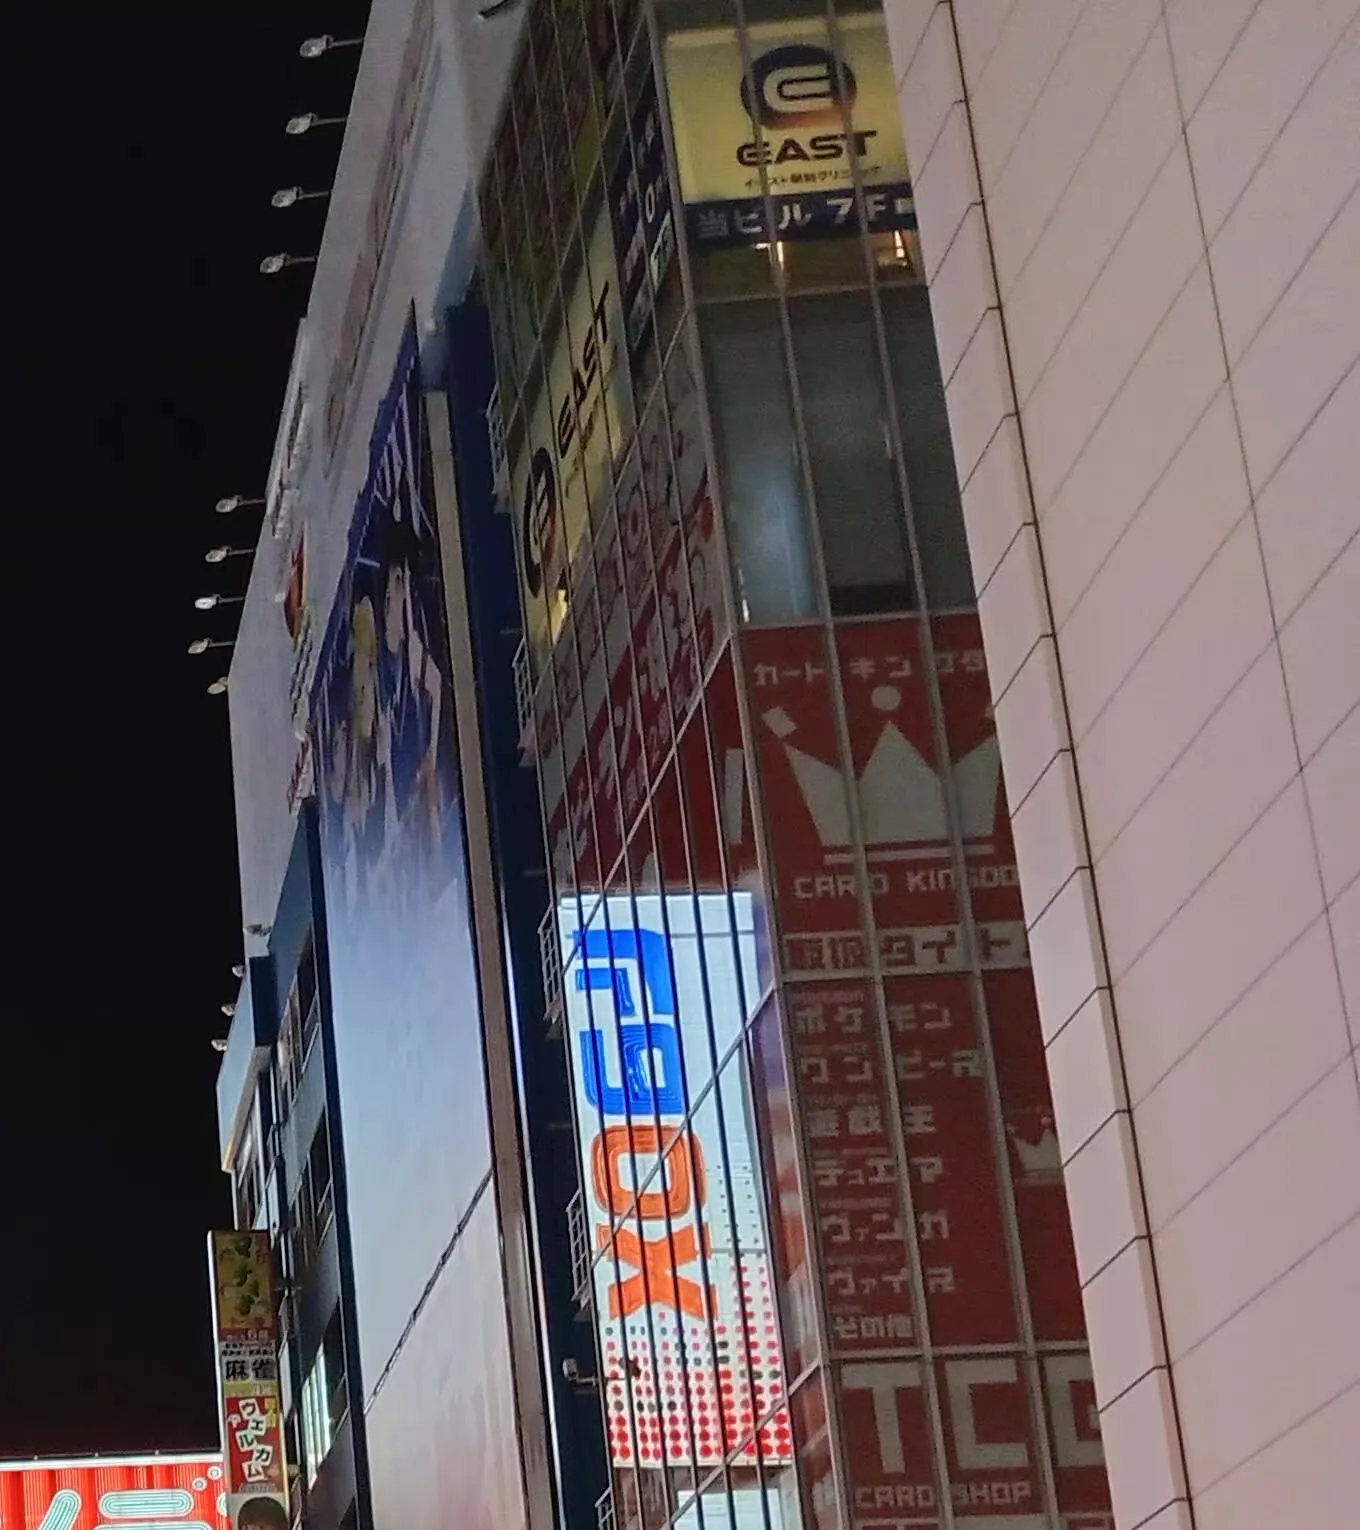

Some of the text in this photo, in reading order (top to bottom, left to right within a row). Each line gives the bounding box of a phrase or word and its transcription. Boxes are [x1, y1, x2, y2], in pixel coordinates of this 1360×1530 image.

[737, 130, 877, 168] EAST
[237, 1399, 272, 1482] ウェルカム
